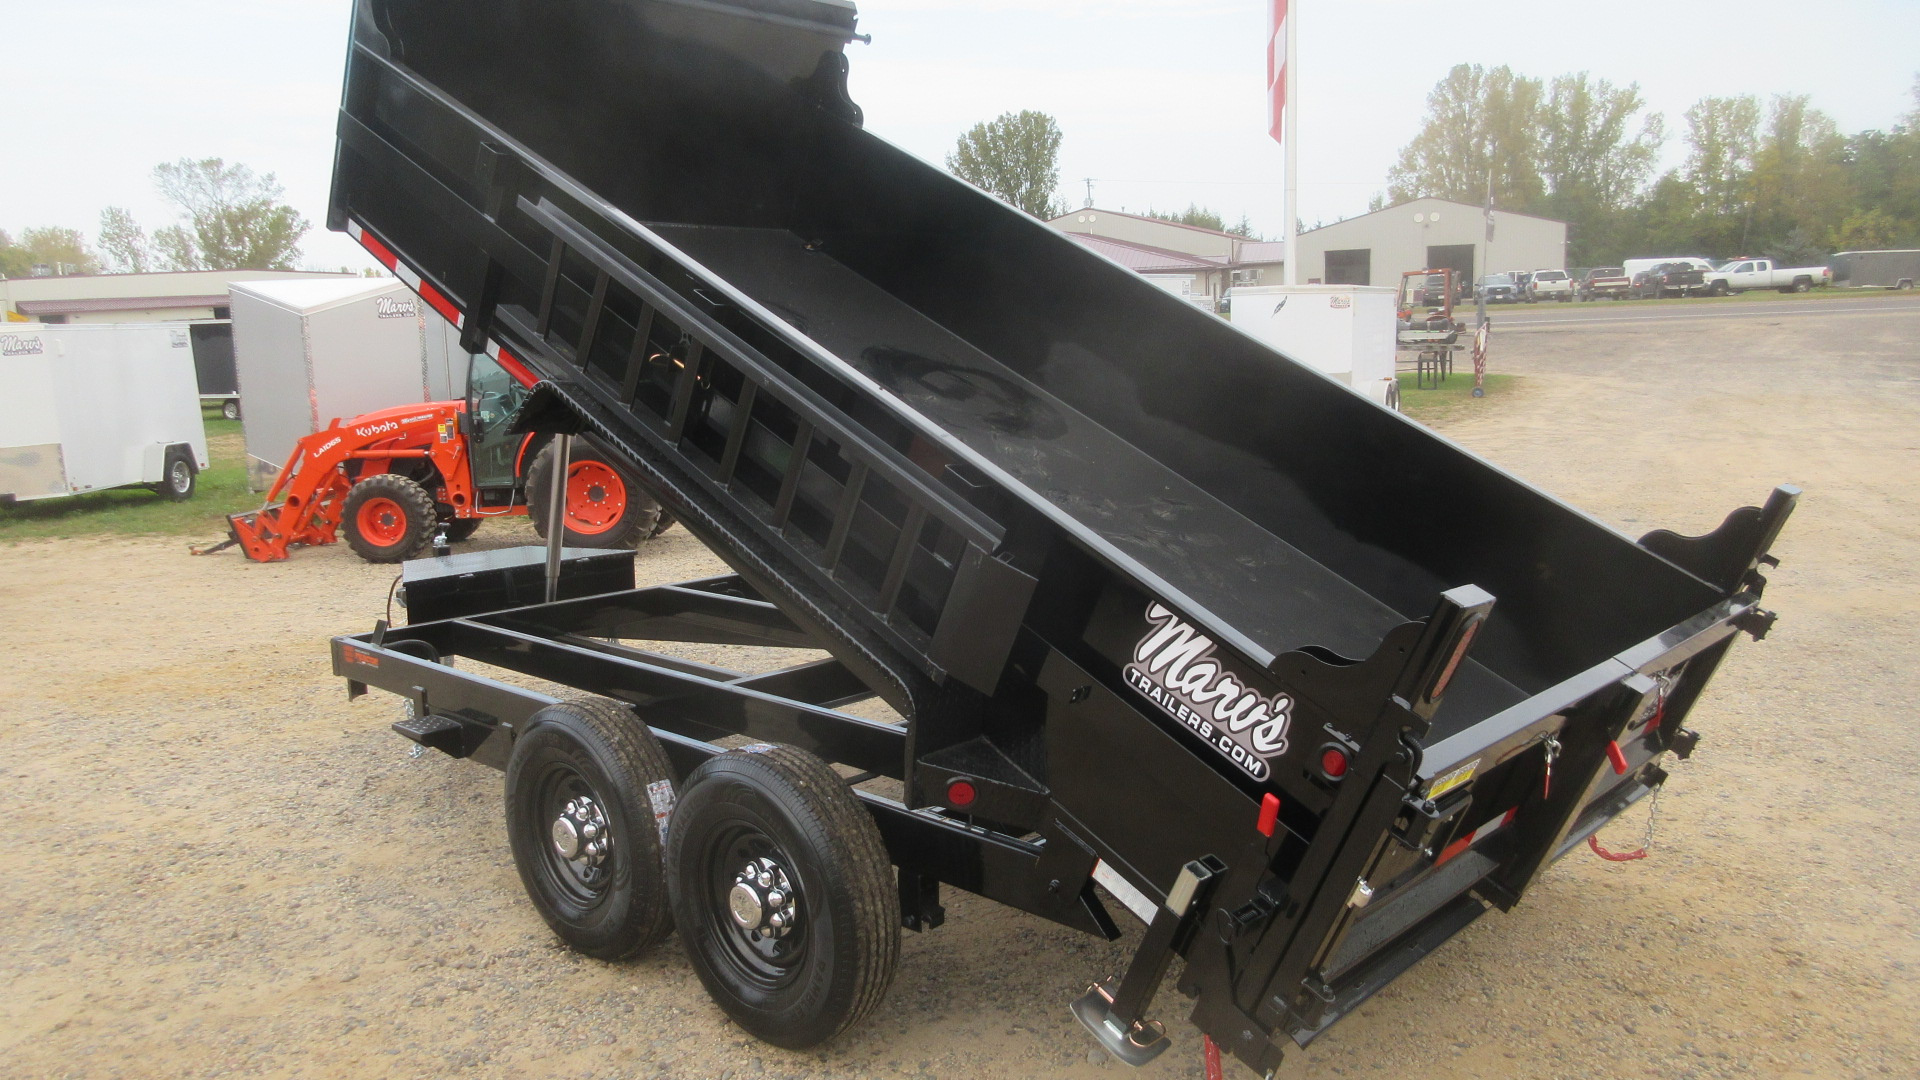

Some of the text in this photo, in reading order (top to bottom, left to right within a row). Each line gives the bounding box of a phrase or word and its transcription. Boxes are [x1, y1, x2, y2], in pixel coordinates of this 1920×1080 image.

[376, 297, 415, 313] Marv's
[0, 335, 42, 351] Marv's
[356, 421, 398, 436] Kubota
[1138, 602, 1290, 752] Marv's
[1130, 668, 1262, 775] TRAILERS.COM
